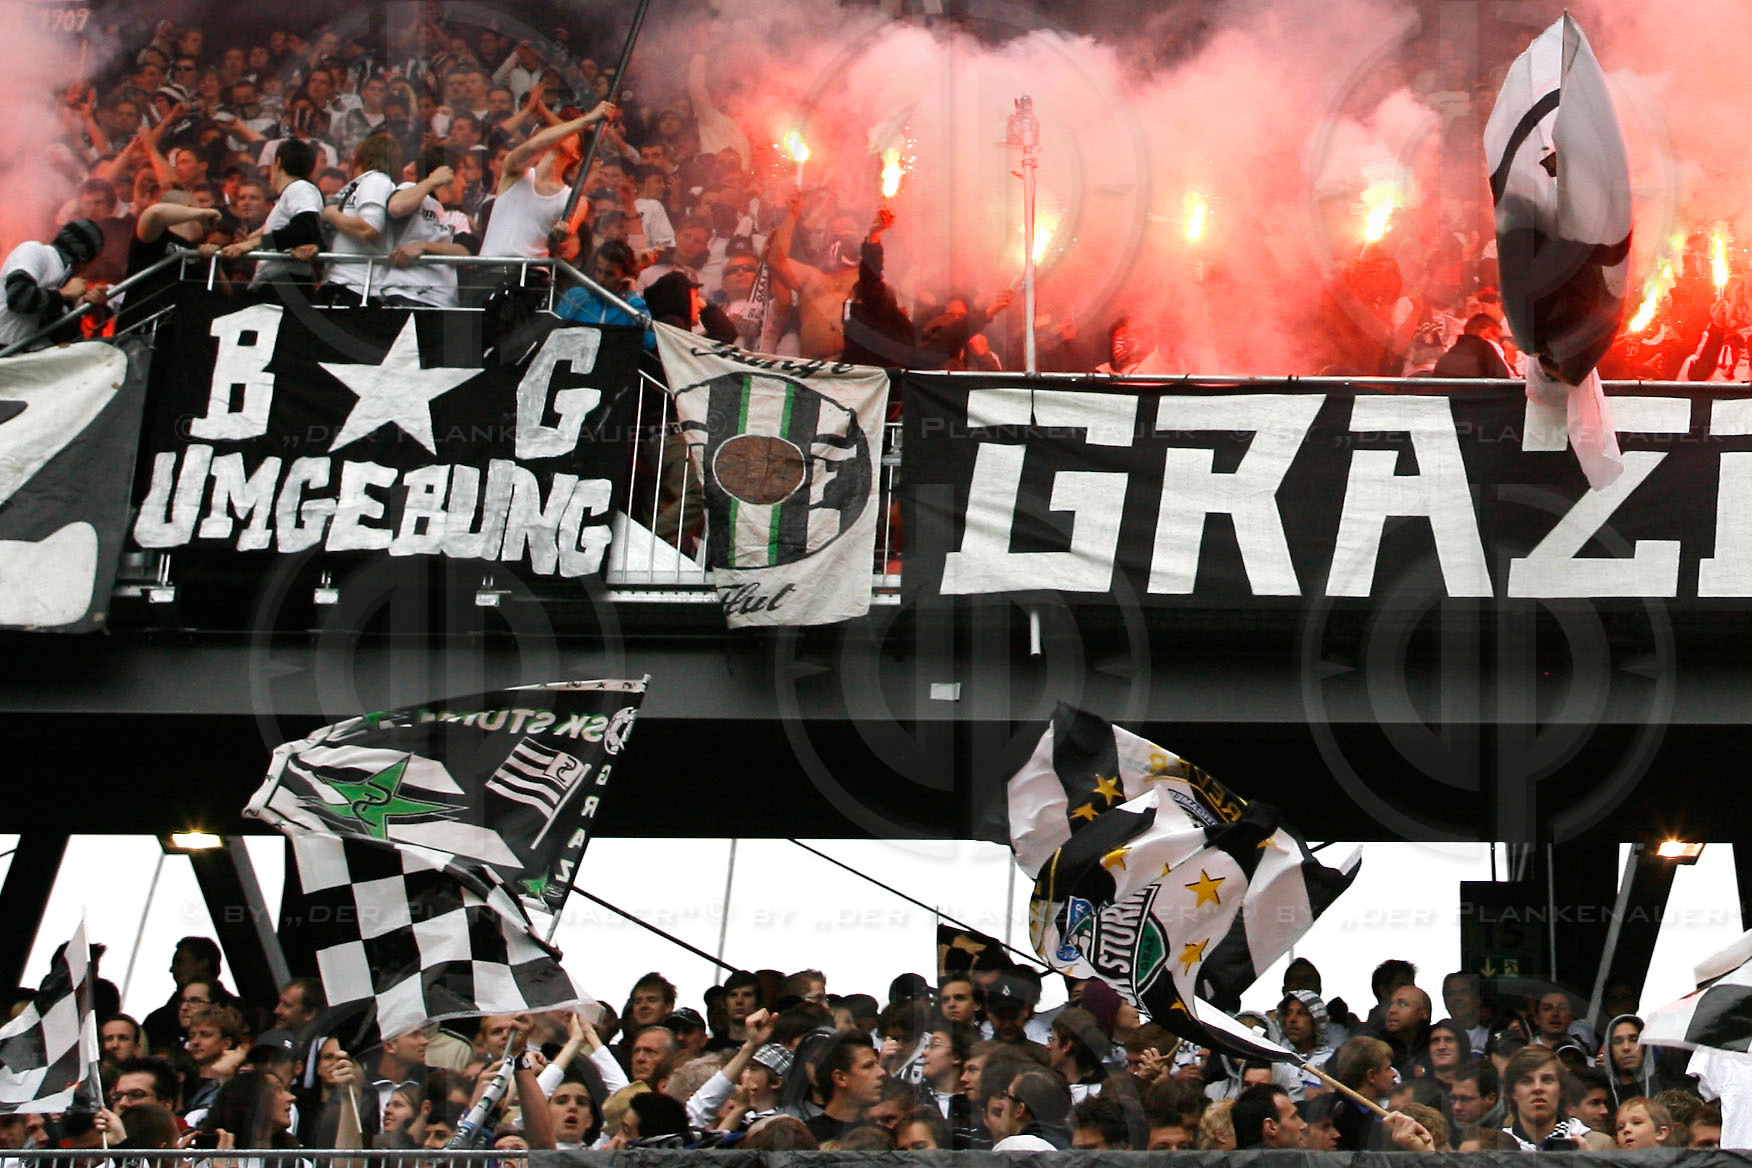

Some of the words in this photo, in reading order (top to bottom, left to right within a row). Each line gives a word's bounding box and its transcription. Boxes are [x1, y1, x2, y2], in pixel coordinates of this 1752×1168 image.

[190, 304, 284, 440] B
[515, 328, 601, 460] G
[133, 444, 613, 578] UMGEBUNG
